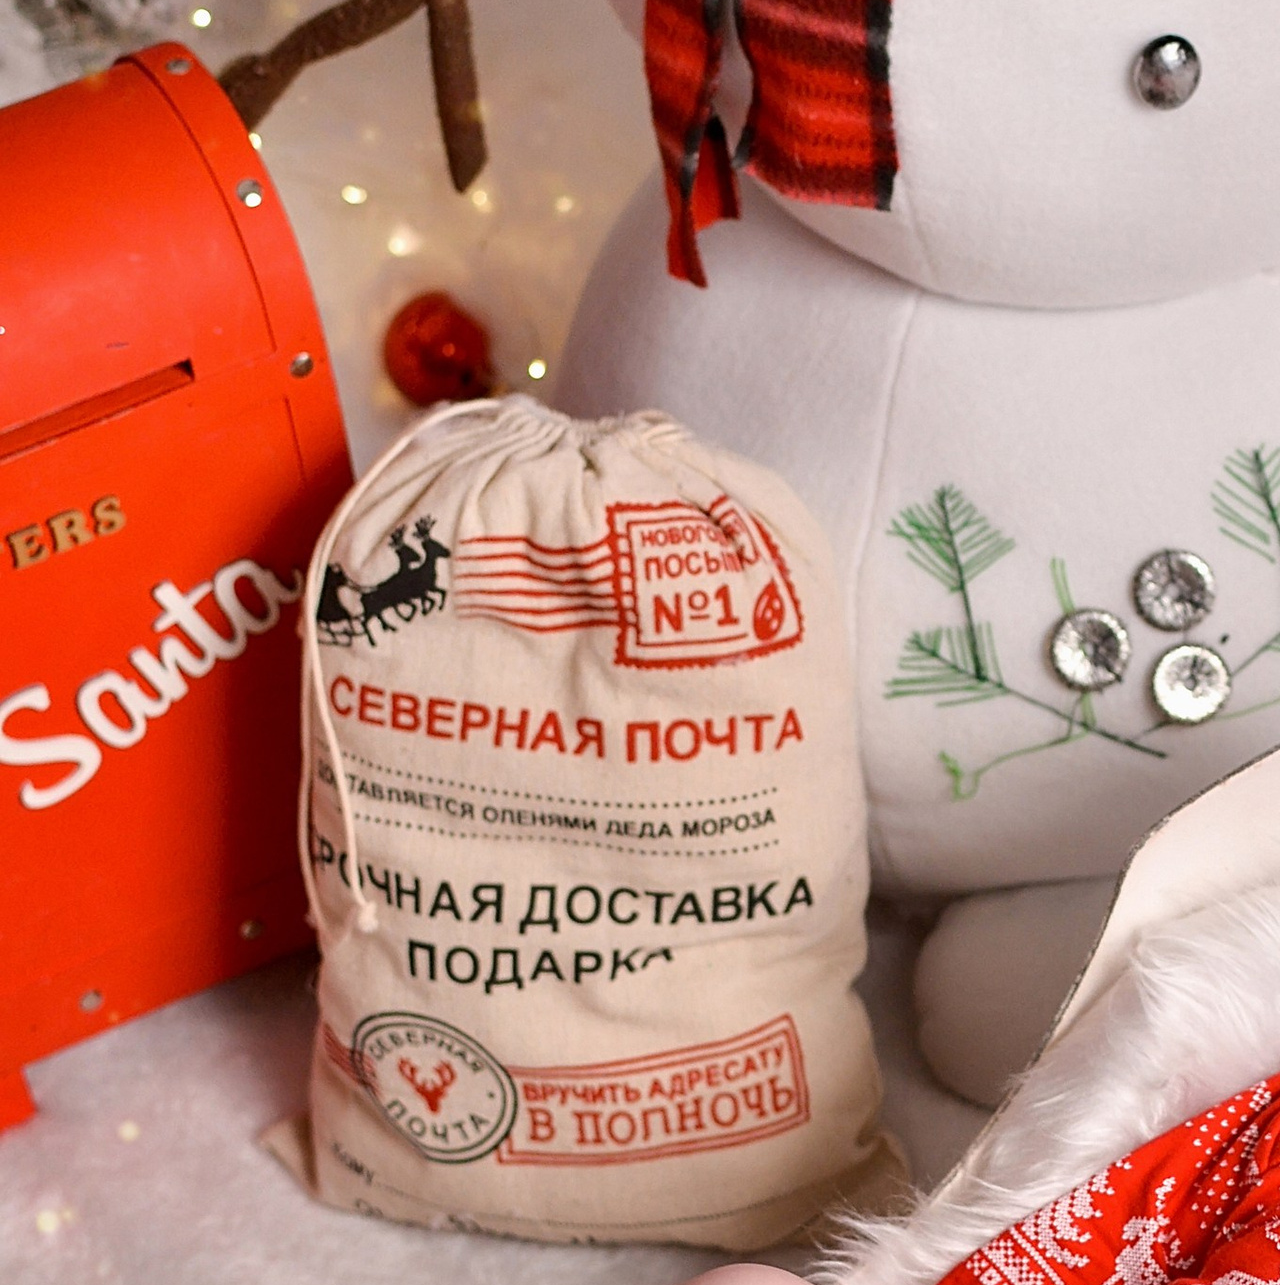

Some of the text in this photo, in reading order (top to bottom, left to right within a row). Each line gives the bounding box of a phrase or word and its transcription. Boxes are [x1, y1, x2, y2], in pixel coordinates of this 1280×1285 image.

[0, 494, 126, 569] ERS
[0, 558, 303, 809] Santa
[330, 674, 804, 763] СЕВЕРНАЯ ПОЧТА
[482, 806, 597, 831] ОЛЕНЯМИ
[605, 819, 674, 839] ДЕДА
[681, 807, 776, 838] МОРОЗА
[316, 833, 814, 934] РОЧНАЯ ДОСТАВКА
[522, 1044, 785, 1105] ВРУЧИТЬ АДРЕСАТУ
[527, 1075, 795, 1146] В ПОЛНОЧЬ
[386, 1098, 490, 1143] ПОЧТА
